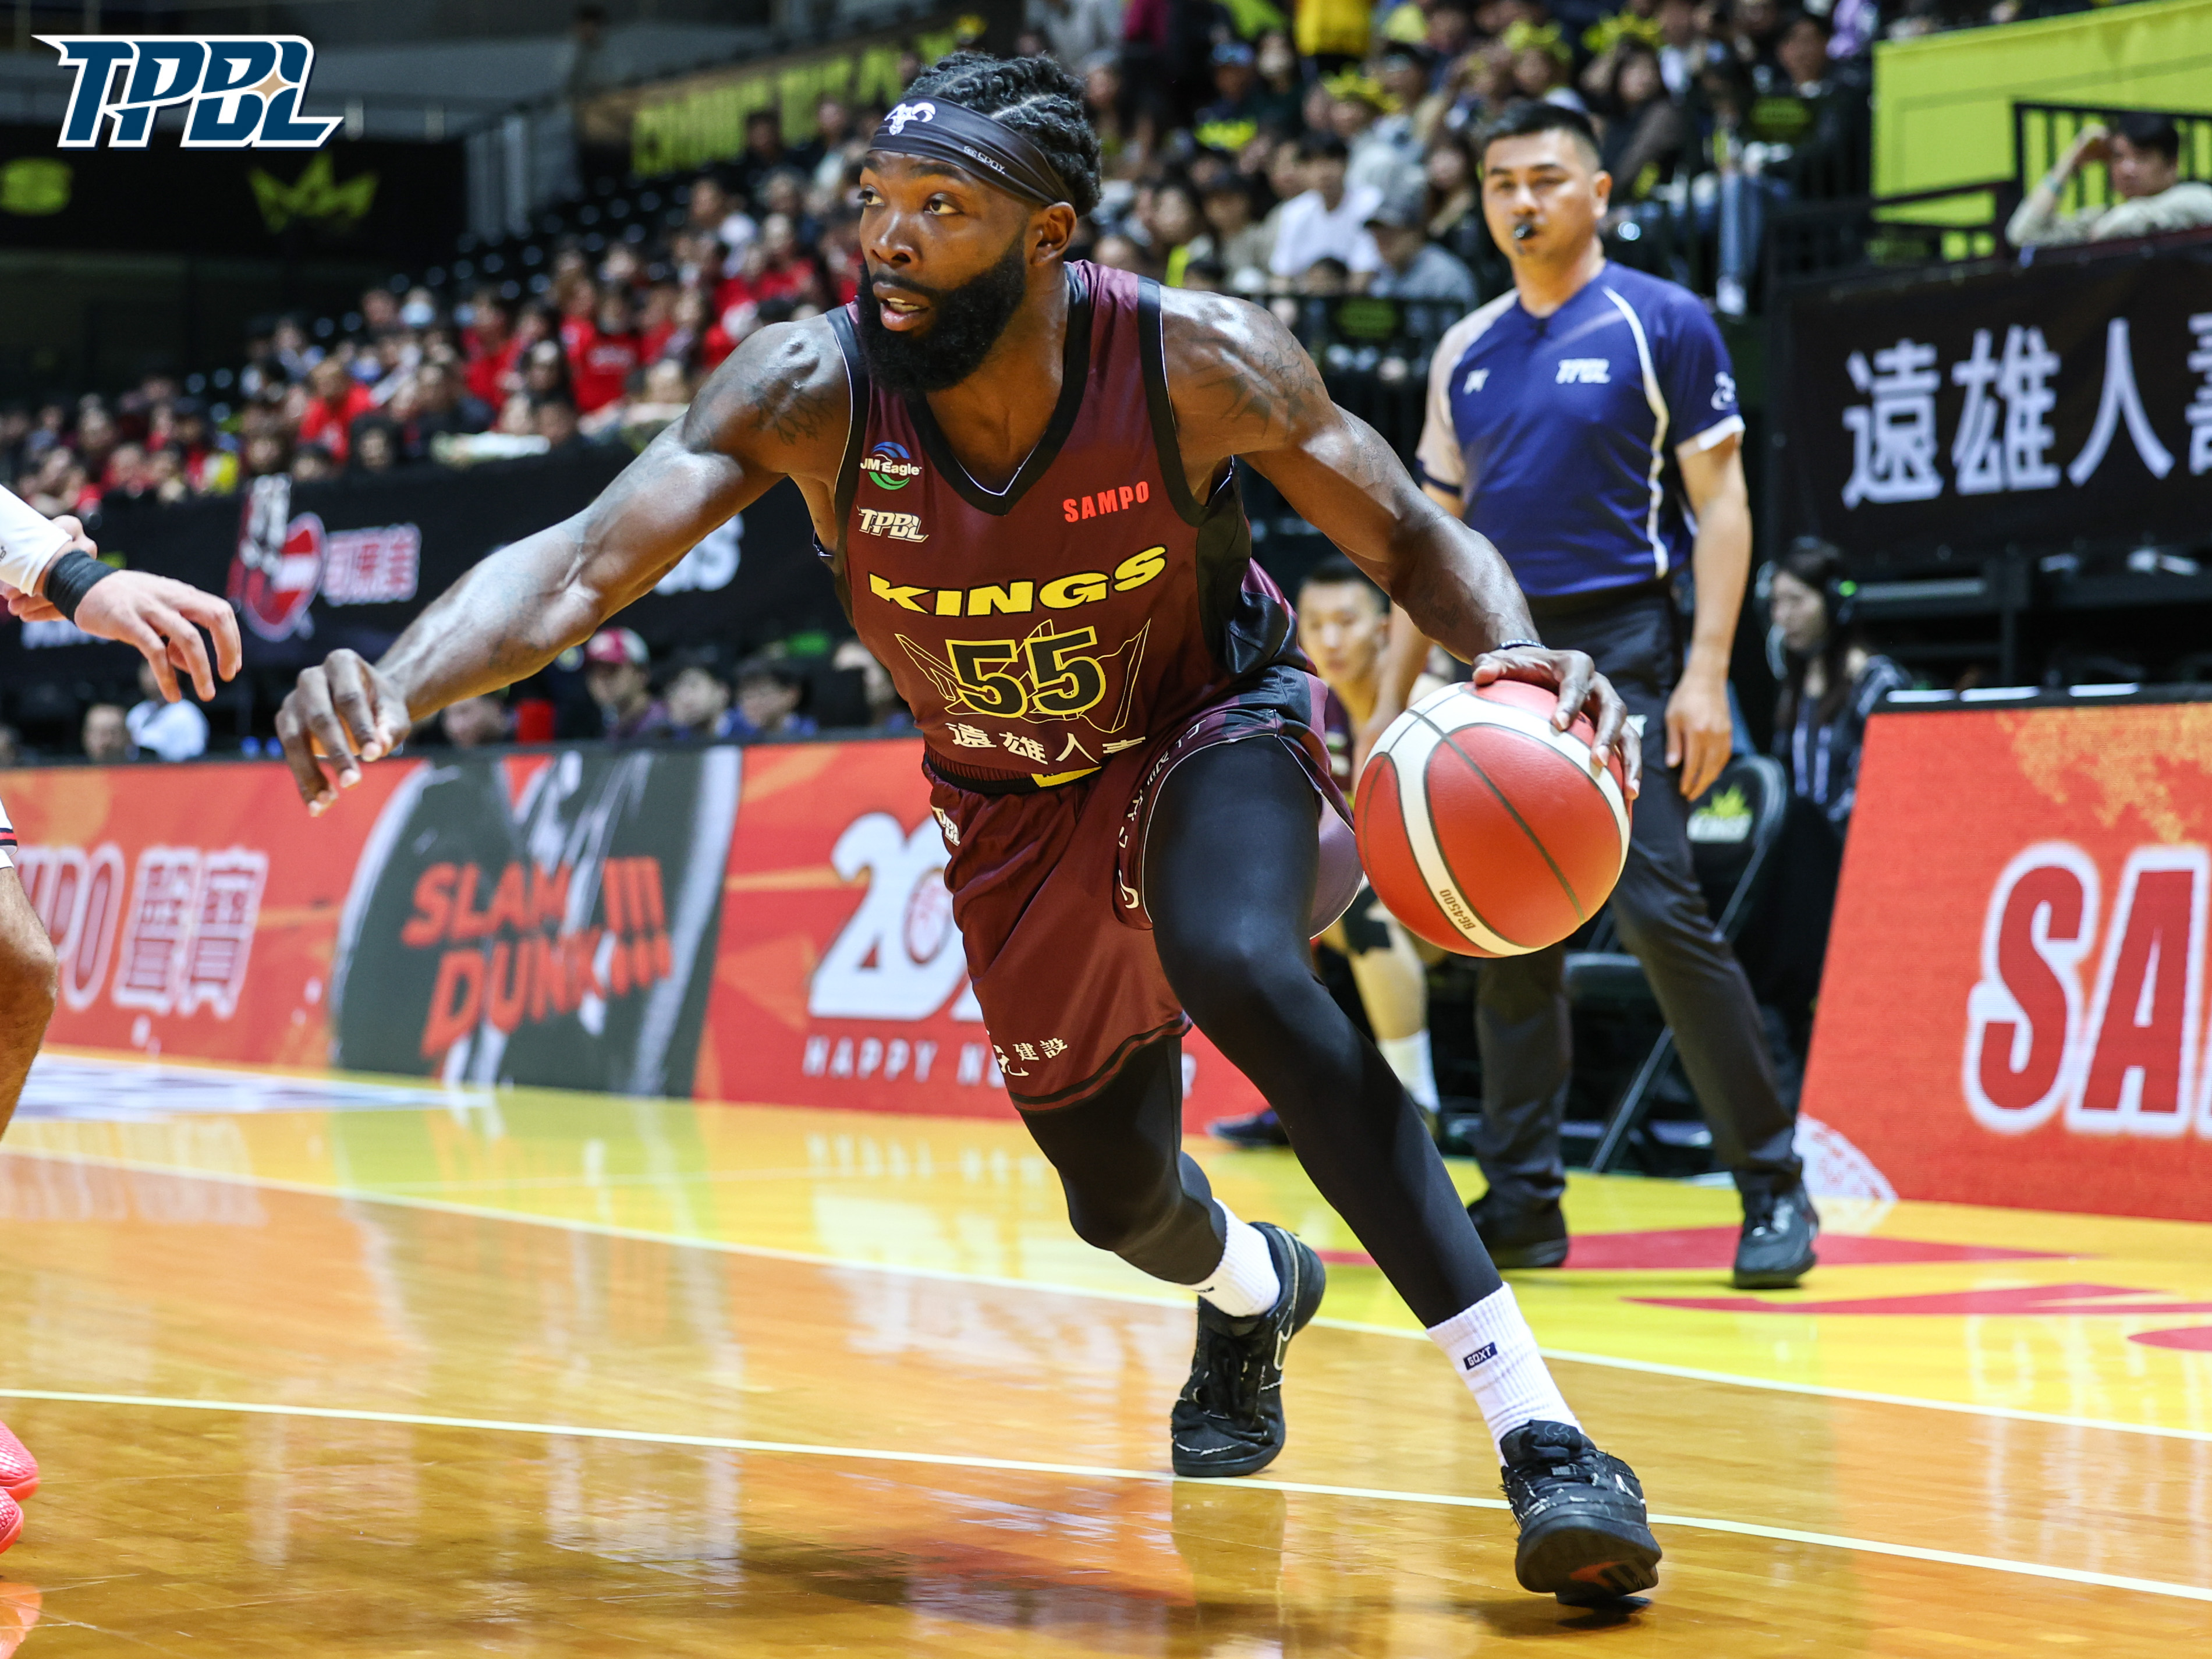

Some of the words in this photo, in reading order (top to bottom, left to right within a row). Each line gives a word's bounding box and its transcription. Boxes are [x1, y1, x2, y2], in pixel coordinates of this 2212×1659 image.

[1841, 311, 2212, 511] 遠雄人
[860, 458, 880, 471] JM
[881, 455, 920, 476] Eagle
[856, 505, 930, 543] TPBL
[1063, 481, 1150, 523] SAMPO
[869, 544, 1167, 617] KINGS
[945, 625, 1107, 718] 55
[401, 860, 575, 949] SLAM
[1439, 888, 1476, 930] BG4500
[1964, 842, 2212, 1139] SA
[802, 1034, 938, 1084] HAPPY
[1466, 1345, 1491, 1367] GOXT
